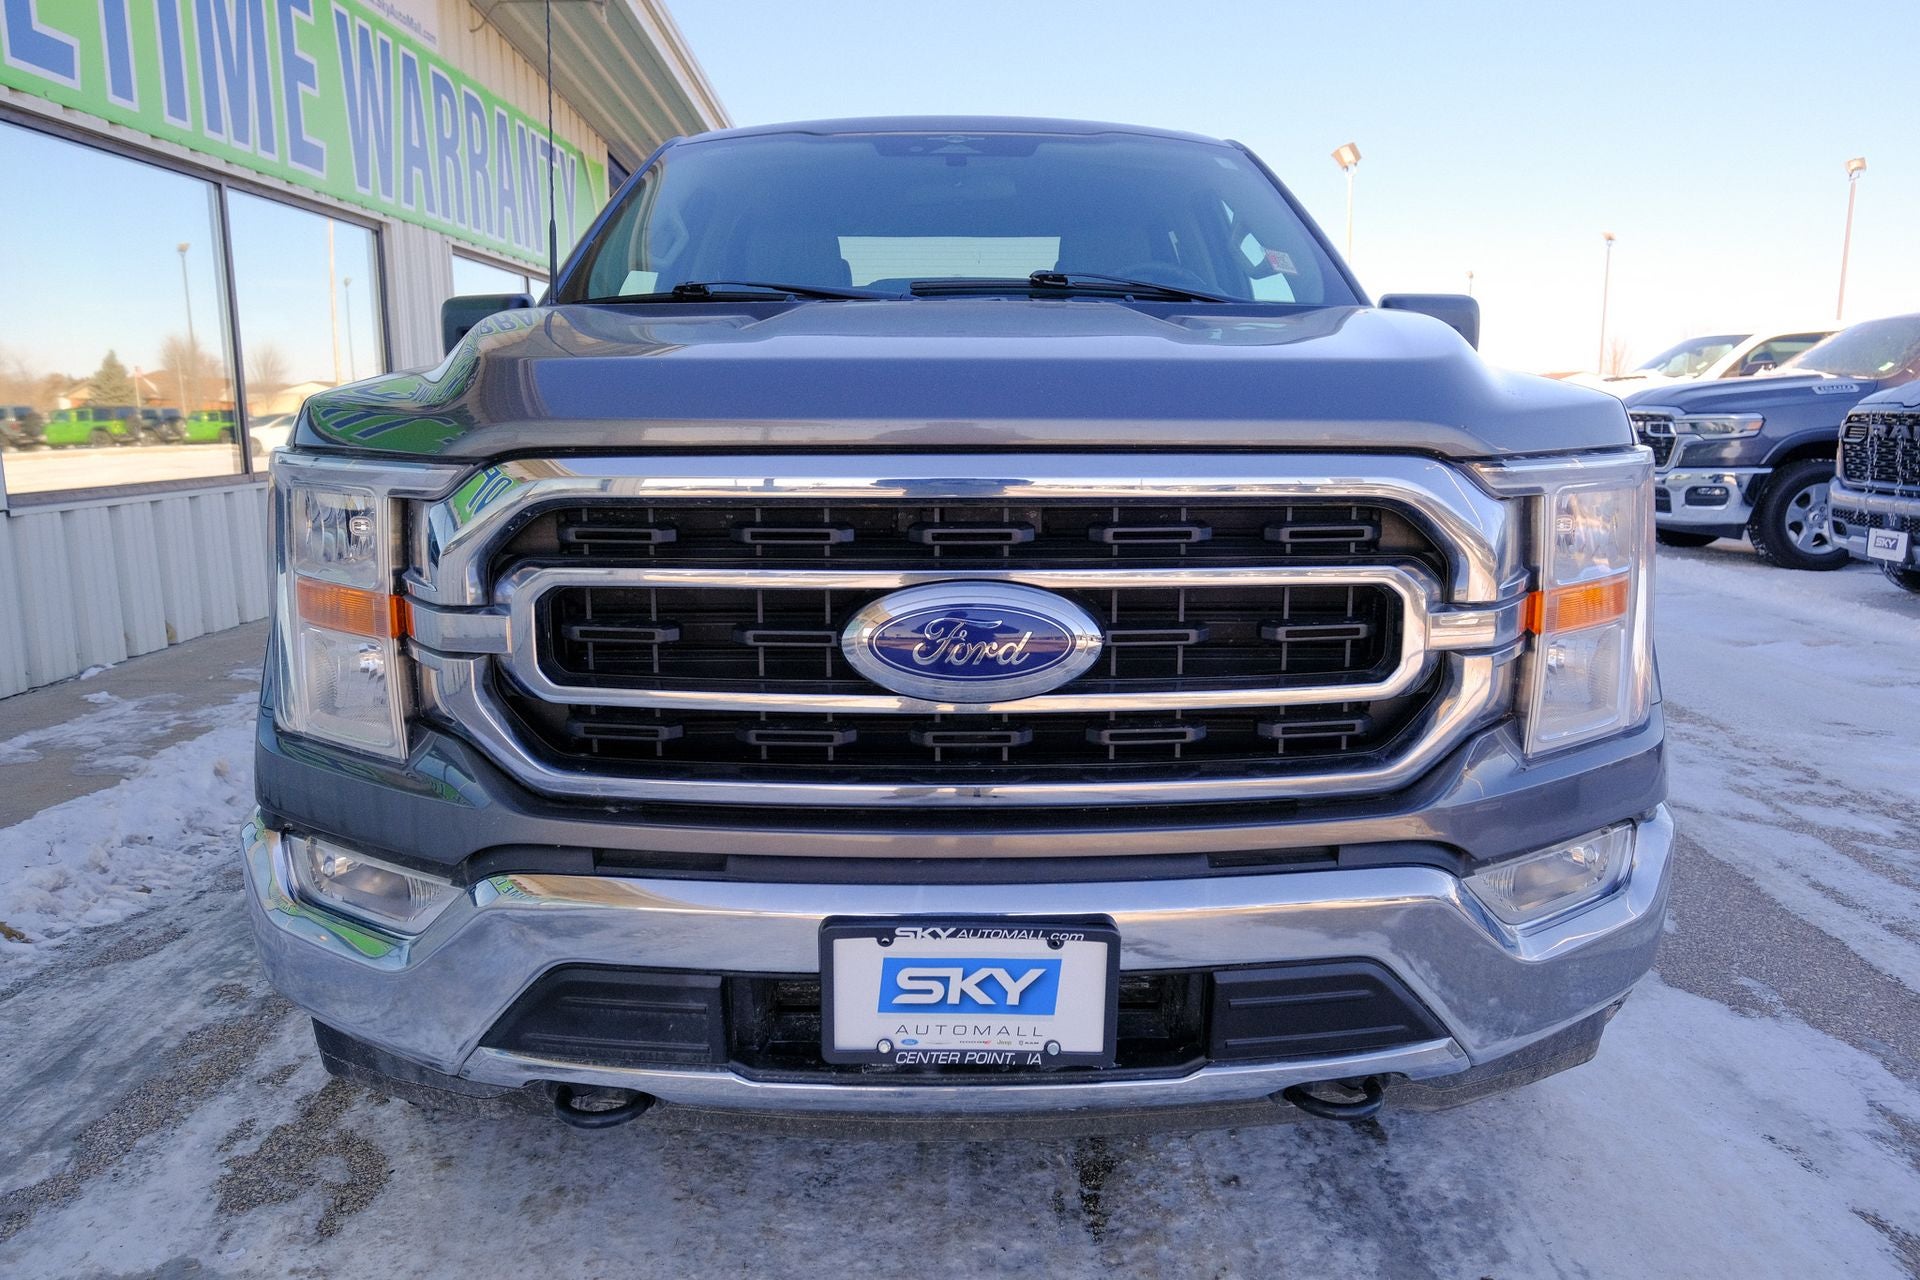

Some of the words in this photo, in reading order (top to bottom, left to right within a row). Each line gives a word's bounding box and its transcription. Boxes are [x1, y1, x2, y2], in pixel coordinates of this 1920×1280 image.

[331, 2, 577, 257] WARRANTY
[1875, 537, 1898, 549] SKY
[912, 617, 1033, 666] Ford
[891, 966, 1048, 1006] SKY
[895, 1024, 1043, 1037] AUTOMALL
[895, 1052, 961, 1065] CENTER
[964, 1052, 1016, 1066] POINT,
[1026, 1052, 1042, 1066] IA
